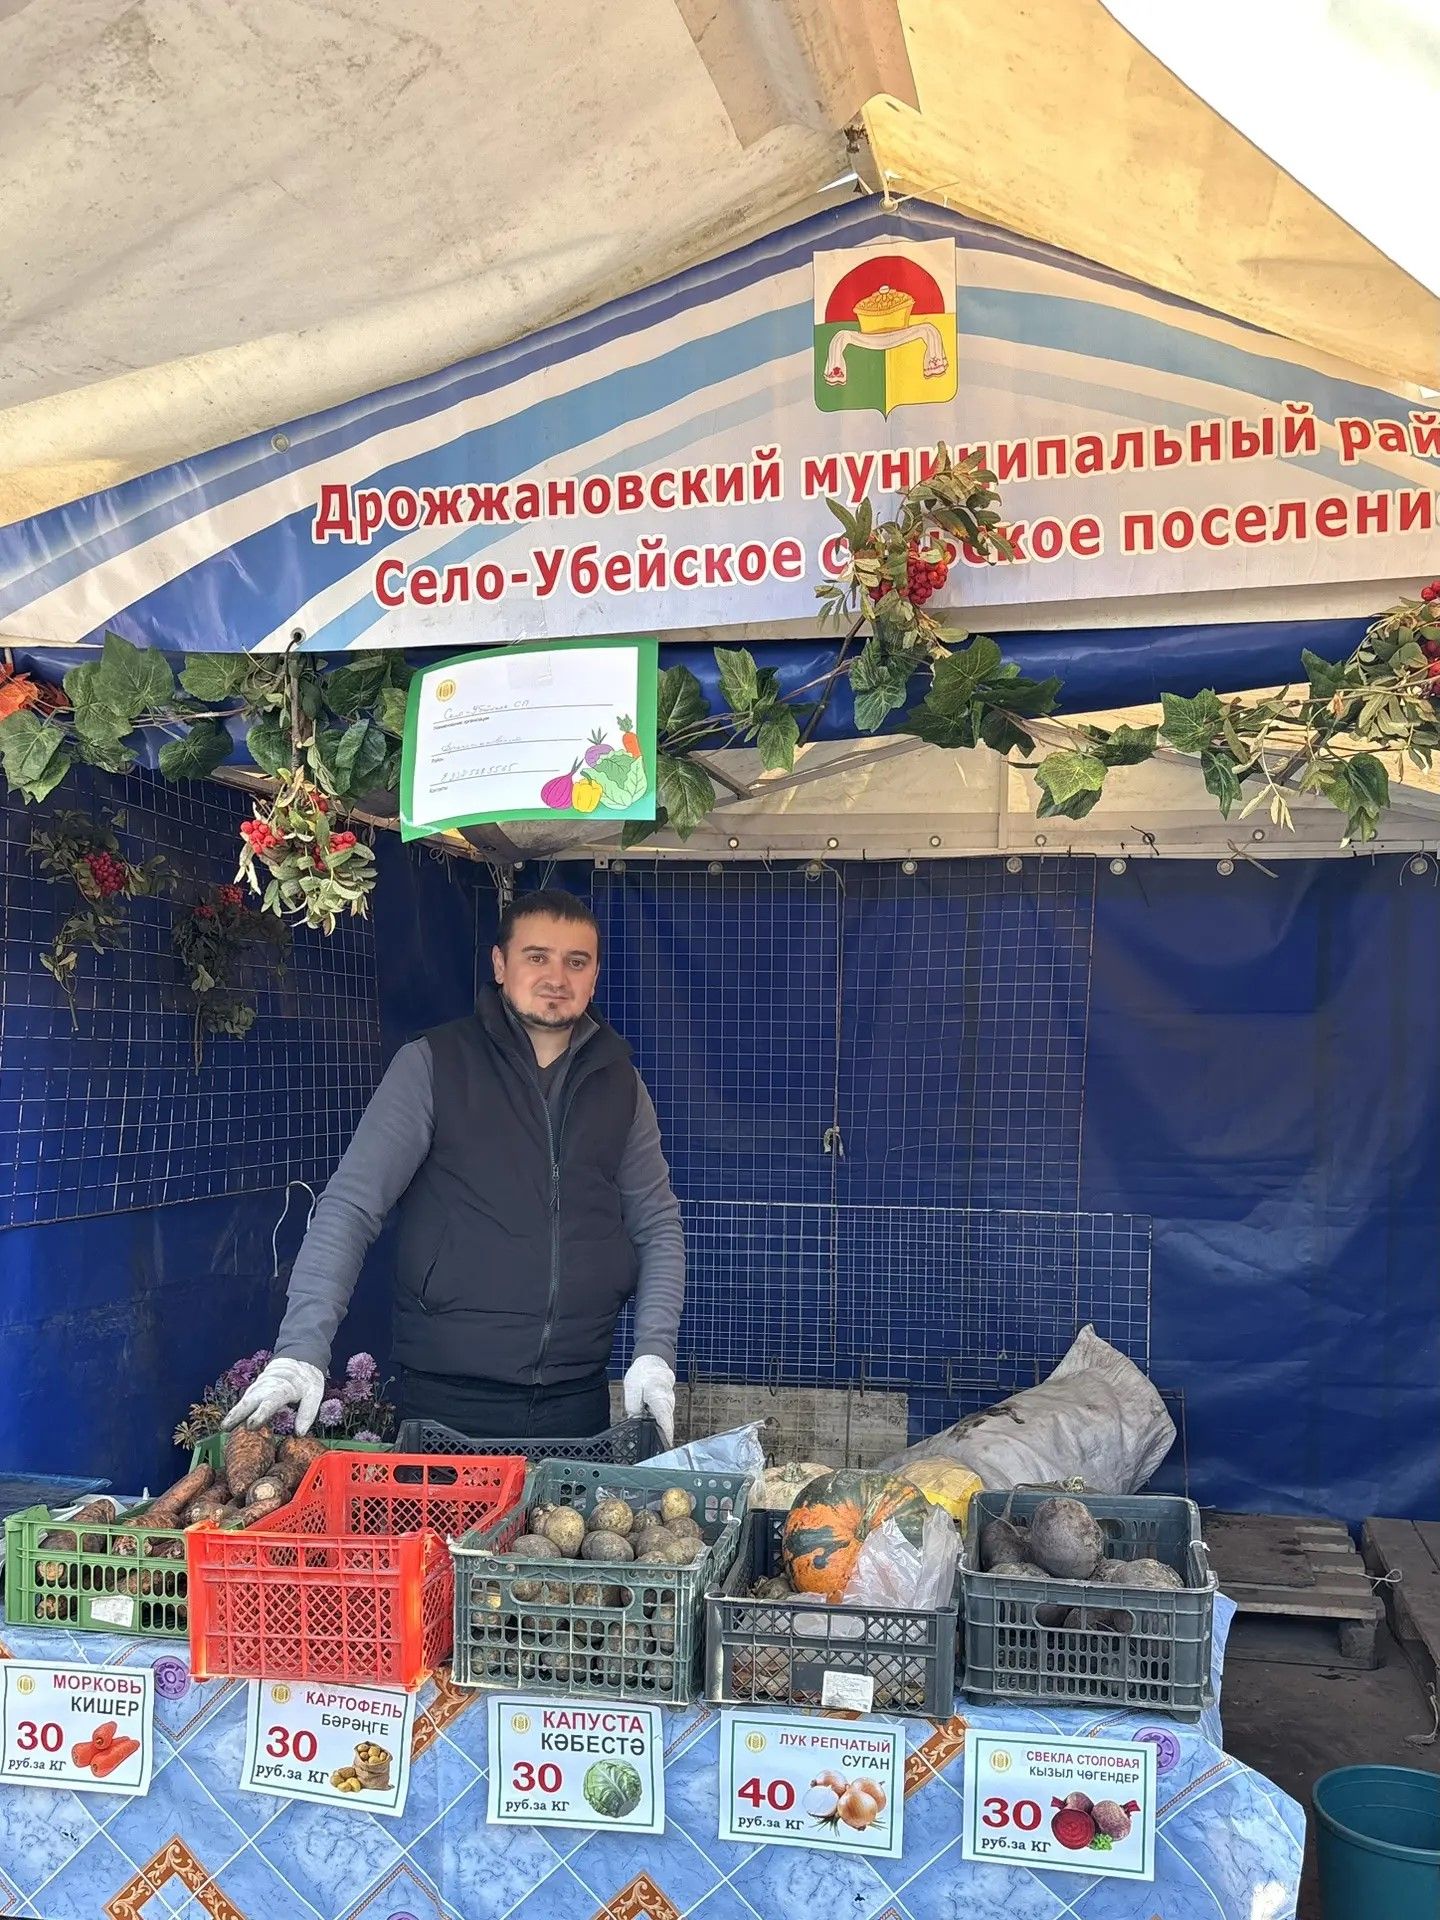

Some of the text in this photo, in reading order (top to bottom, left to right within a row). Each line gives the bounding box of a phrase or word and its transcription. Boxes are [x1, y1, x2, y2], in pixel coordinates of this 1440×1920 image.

[315, 447, 780, 542] Дрожжановский
[804, 403, 1316, 504] мунипальный
[374, 535, 802, 606] Село-Убейское
[53, 1674, 142, 1695] МОРКОВЬ
[71, 1696, 140, 1717] КИШЕР
[305, 1690, 403, 1719] КАРТОФЕЛЬ
[321, 1714, 390, 1736] БӘРӘҢГЕ
[543, 1710, 645, 1734] КАПУСТА
[16, 1720, 64, 1752] 30
[265, 1725, 318, 1763] 30
[541, 1733, 645, 1756] КӘБЕСТӘ
[779, 1733, 891, 1753] ЛУК РЕПЧАТЫЙ
[8, 1757, 66, 1771] руб.за КГ
[841, 1754, 890, 1770] СУГАН
[1026, 1750, 1140, 1769] СВЕКЛА СТОЛОВАЯ
[255, 1764, 329, 1784] руб.за КГ
[512, 1761, 563, 1793] 30
[1029, 1765, 1140, 1784] КЫЗЫЛ ЧӨГЕНДЕР
[737, 1777, 796, 1811] 40
[505, 1799, 570, 1812] руб.за КГ
[981, 1796, 1042, 1831] 30
[737, 1816, 805, 1830] руб.за КГ
[981, 1837, 1052, 1853] руб.за КГ
